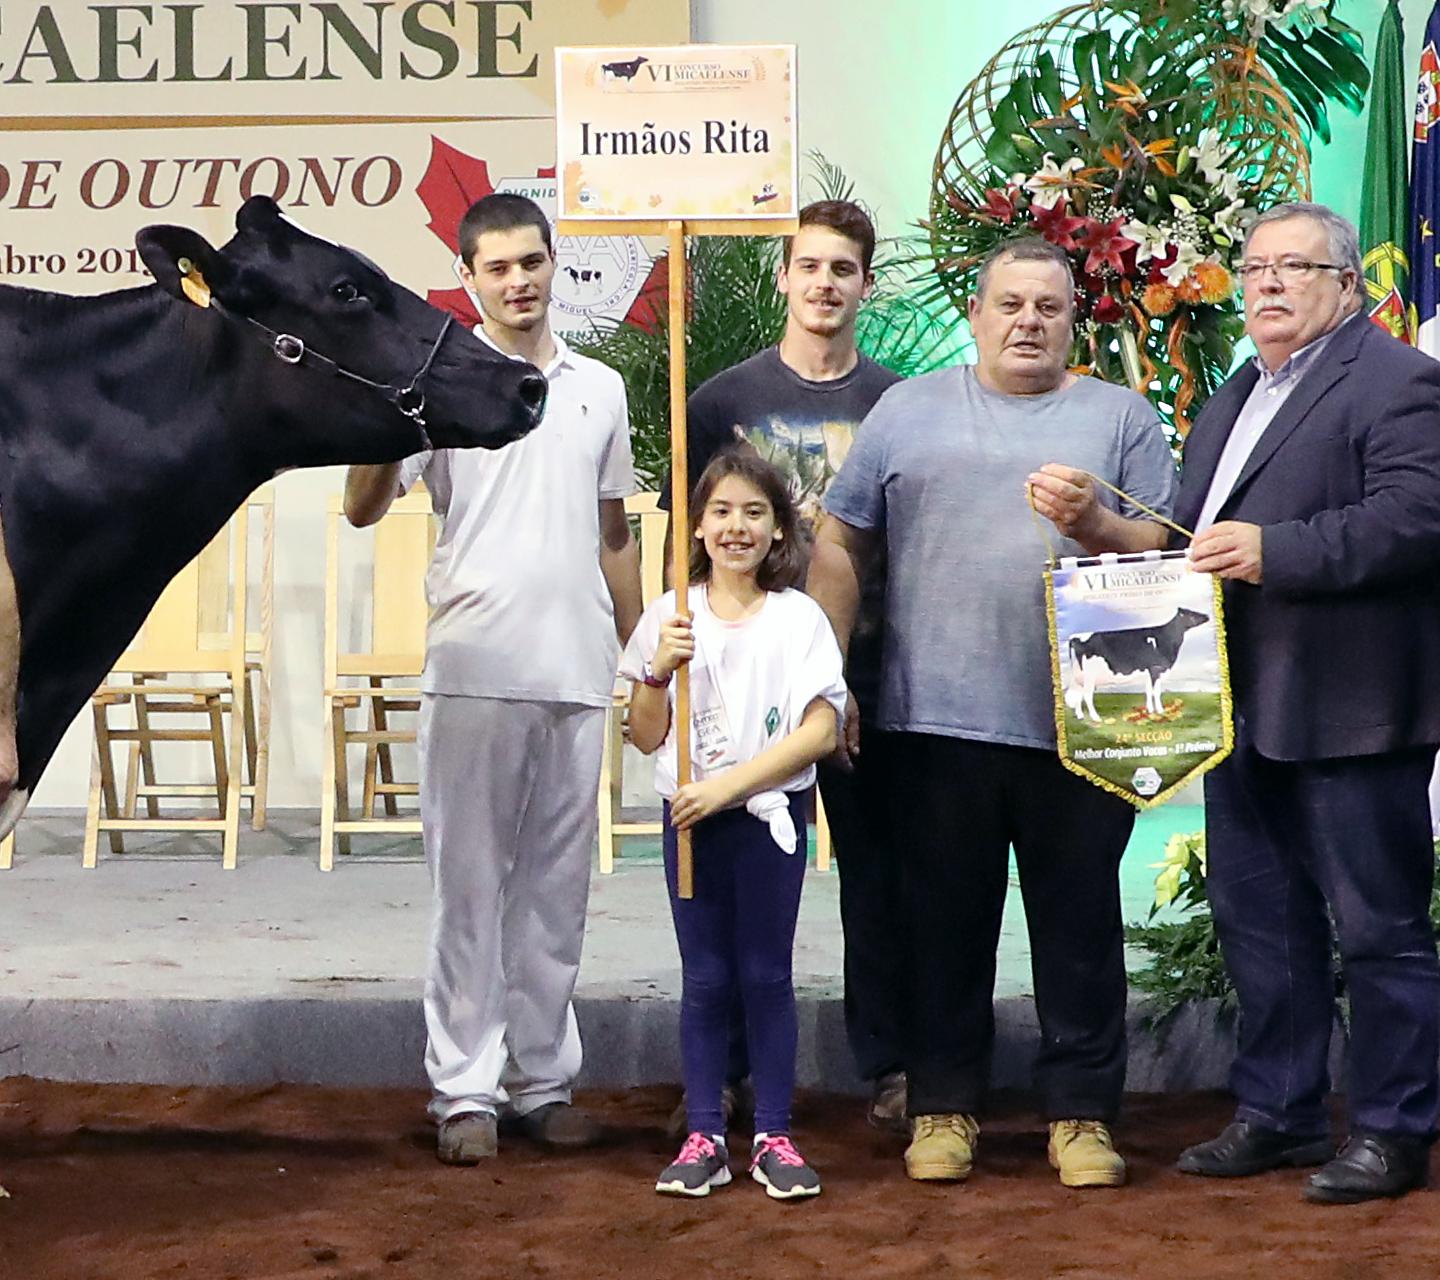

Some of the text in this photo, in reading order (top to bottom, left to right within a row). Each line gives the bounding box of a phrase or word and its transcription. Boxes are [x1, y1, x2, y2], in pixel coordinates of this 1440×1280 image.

[647, 64, 672, 82] VI
[580, 120, 770, 156] Irmãos Rita
[79, 155, 403, 210] OUTONO
[503, 188, 556, 199] DIGNID
[76, 247, 154, 277] 201
[1084, 573, 1108, 590] VI
[1074, 748, 1103, 760] Melhor
[1104, 747, 1142, 760] Conjunto
[1143, 745, 1168, 757] Vacas
